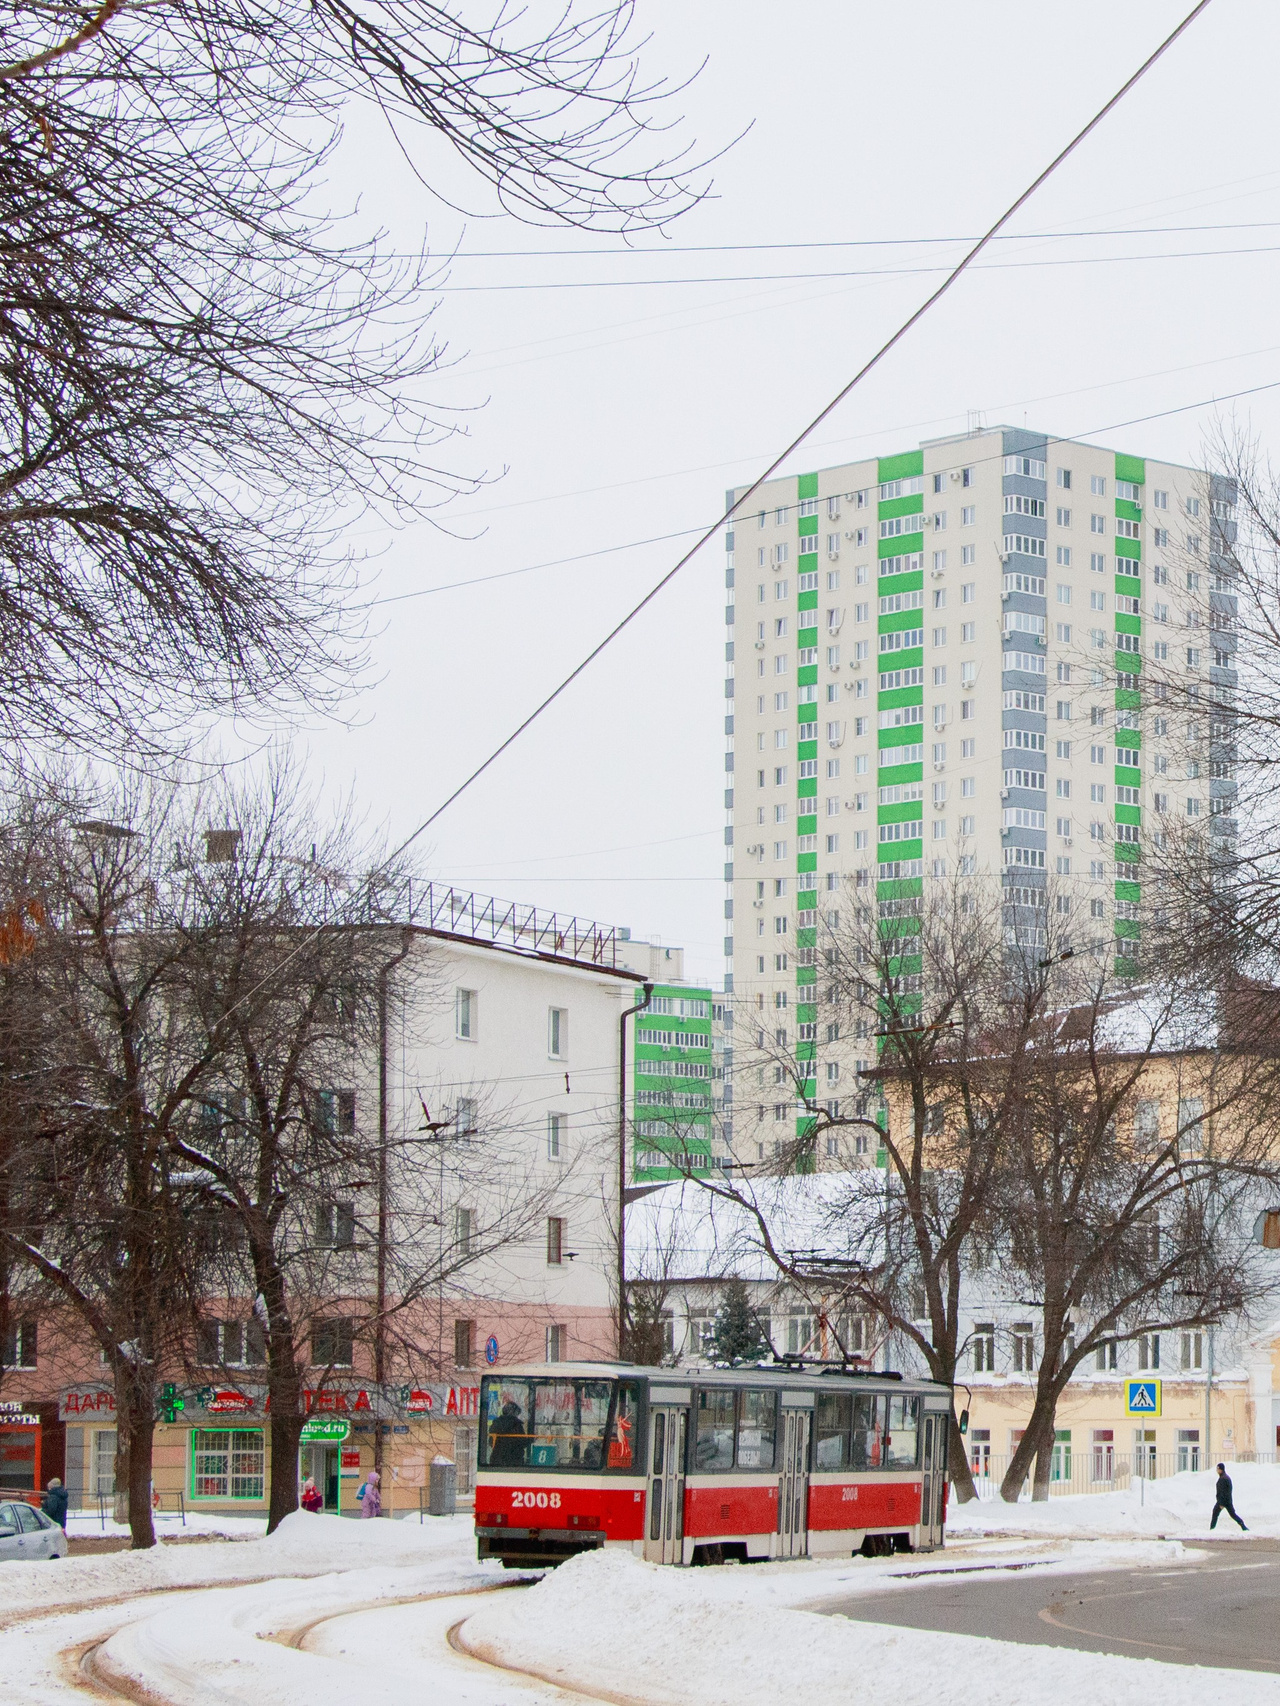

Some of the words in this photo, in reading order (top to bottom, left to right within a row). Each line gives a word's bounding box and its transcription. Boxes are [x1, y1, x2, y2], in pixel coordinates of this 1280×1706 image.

[538, 1449, 547, 1465] 8
[511, 1491, 562, 1509] 2008
[841, 1486, 859, 1501] 2008
